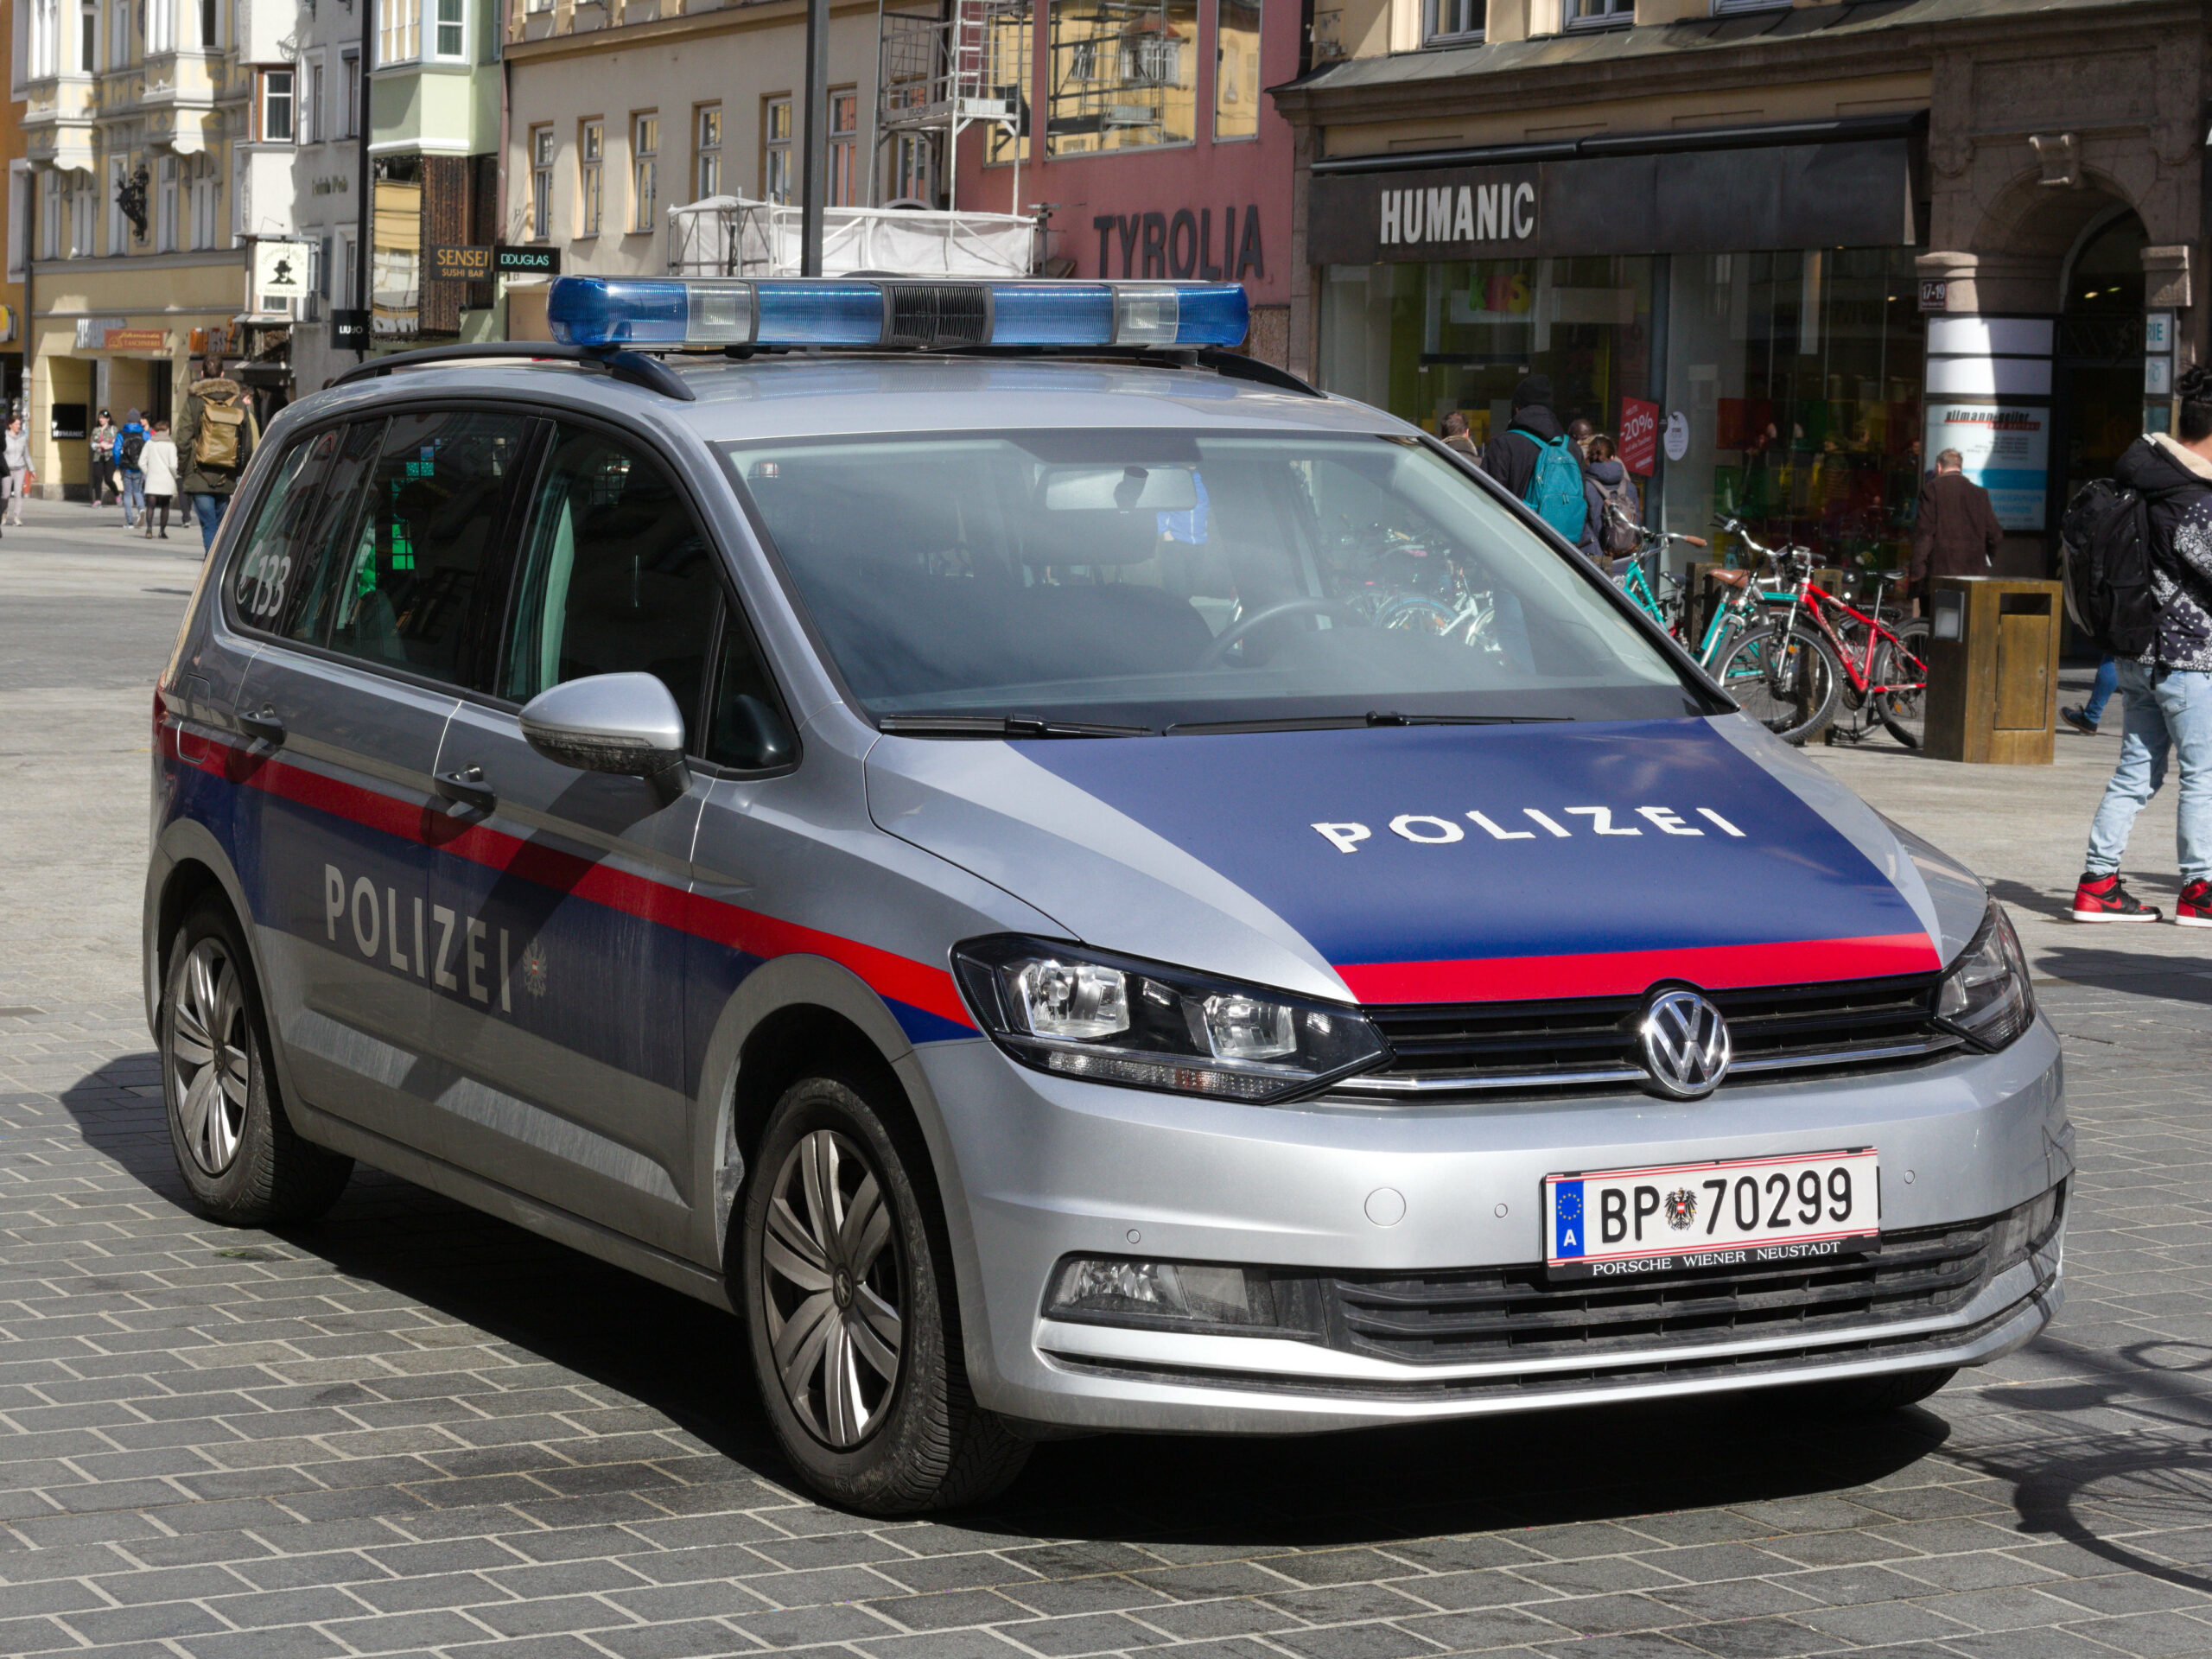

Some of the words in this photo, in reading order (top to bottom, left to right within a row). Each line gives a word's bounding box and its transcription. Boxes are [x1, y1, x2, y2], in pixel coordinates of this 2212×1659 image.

[1381, 182, 1535, 244] HUMANIC
[436, 248, 489, 267] SENSEI
[1093, 204, 1264, 280] TYROLIA
[442, 268, 465, 277] SUSHI
[467, 268, 484, 277] BAR
[500, 253, 550, 266] DOUGLAS
[1620, 411, 1654, 442] -20%
[1311, 806, 1746, 854] POLIZEI
[325, 864, 511, 1013] POLIZEI
[1601, 1185, 1660, 1244] BP
[1702, 1166, 1853, 1236] 70299
[1563, 1229, 1577, 1247] A
[1592, 1258, 1673, 1276] PORSCHE
[1683, 1251, 1746, 1268] WIENER
[1758, 1242, 1841, 1261] NEUSTADT
